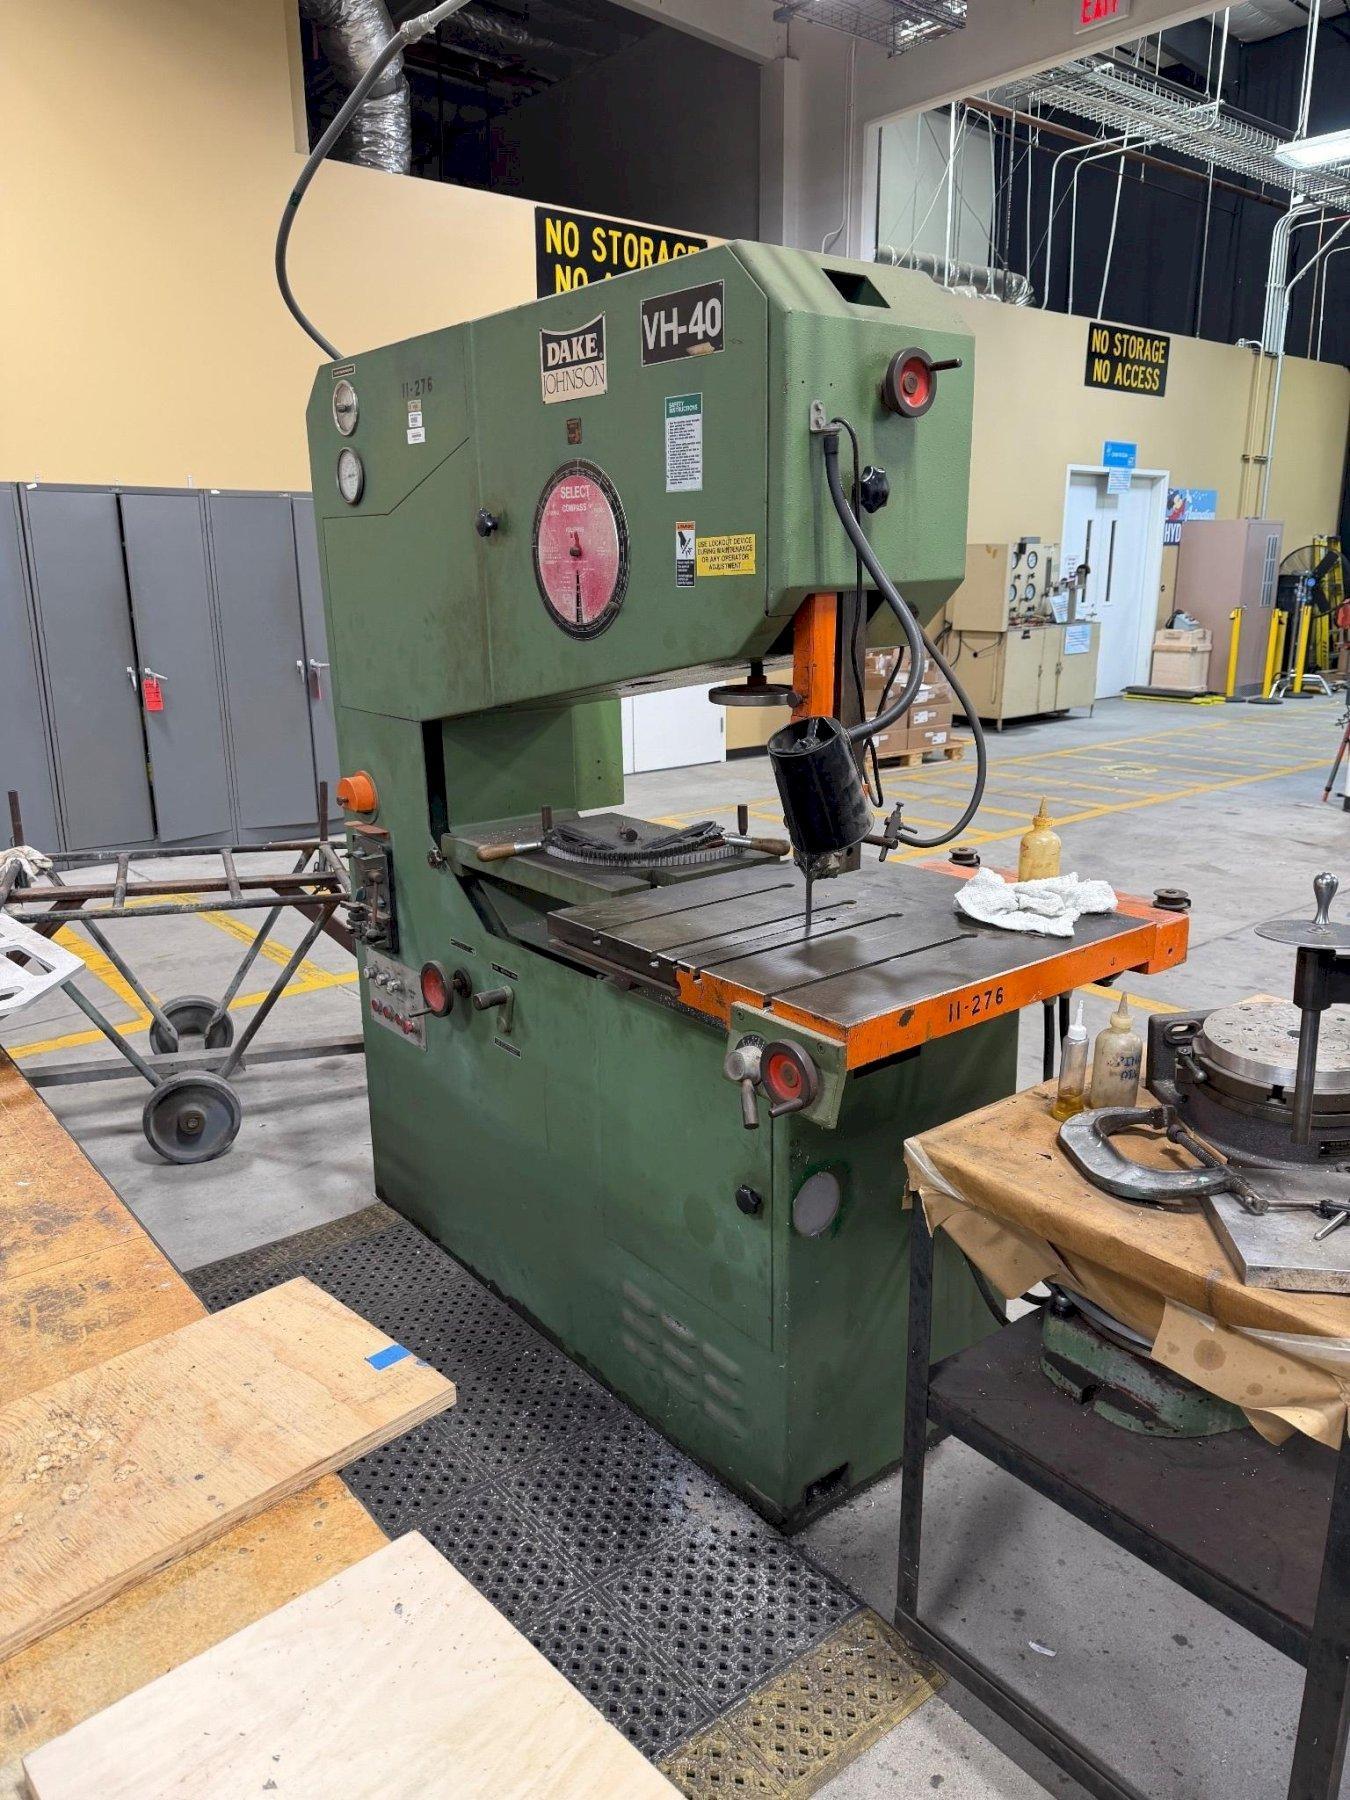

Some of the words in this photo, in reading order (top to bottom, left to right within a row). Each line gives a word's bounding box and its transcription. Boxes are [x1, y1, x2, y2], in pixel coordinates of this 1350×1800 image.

[545, 217, 580, 258] NO
[592, 226, 701, 269] STORA
[642, 297, 722, 350] VH-40
[546, 332, 599, 367] DAKE
[1091, 328, 1109, 354] NO
[1113, 332, 1167, 363] STORAGE
[402, 376, 432, 399] 11-276
[543, 363, 605, 397] JOHNSON
[1093, 358, 1110, 384] NO
[1114, 362, 1160, 391] ACCESS
[560, 485, 590, 499] SELECT
[698, 540, 707, 548] USE
[709, 539, 732, 547] LOCKOUT
[734, 537, 753, 545] DEVICE
[721, 554, 749, 562] OPERATOR
[949, 987, 1003, 1022] 11-276
